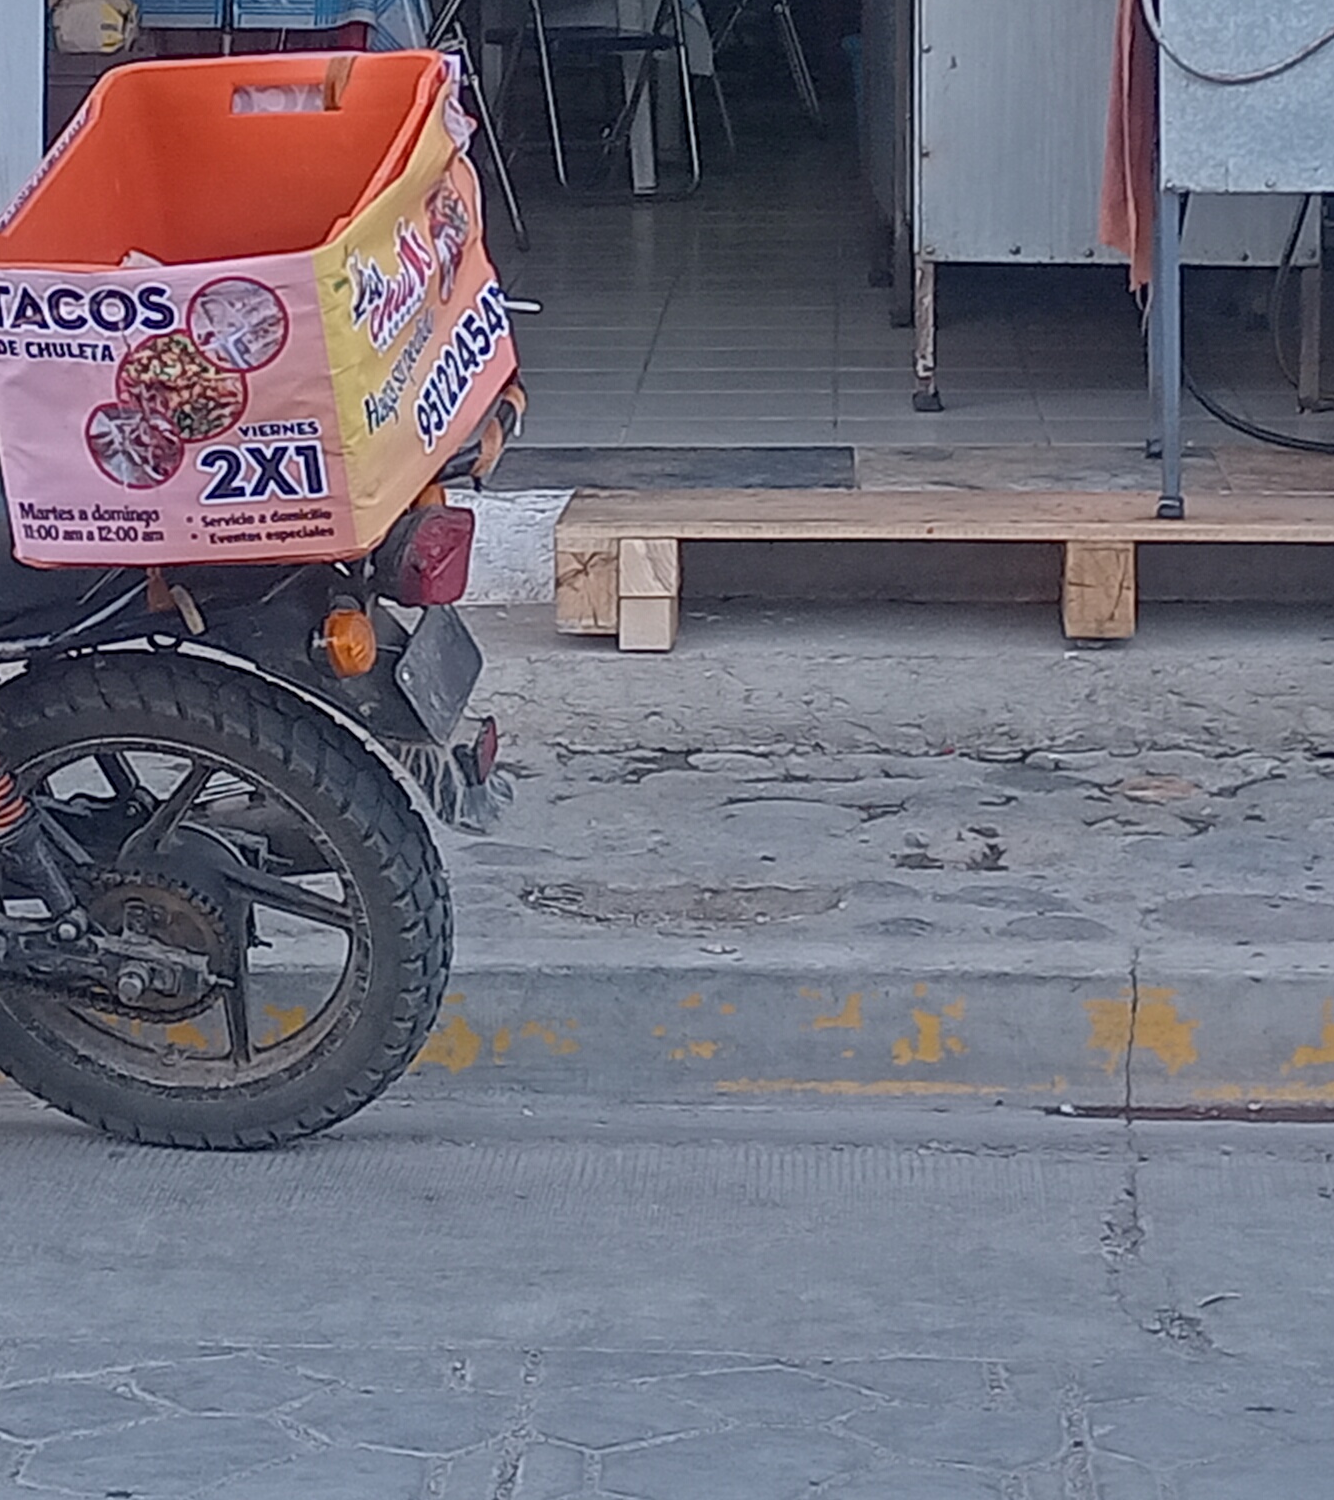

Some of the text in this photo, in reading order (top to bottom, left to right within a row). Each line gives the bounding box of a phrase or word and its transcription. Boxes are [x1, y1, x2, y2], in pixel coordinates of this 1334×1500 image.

[26, 341, 115, 362] CHULETA
[238, 422, 319, 438] VIERNES
[200, 445, 324, 500] 2X1
[18, 502, 160, 528] Martes a domingo
[201, 513, 254, 528] Servicio
[62, 529, 84, 541] am
[141, 529, 164, 542] am
